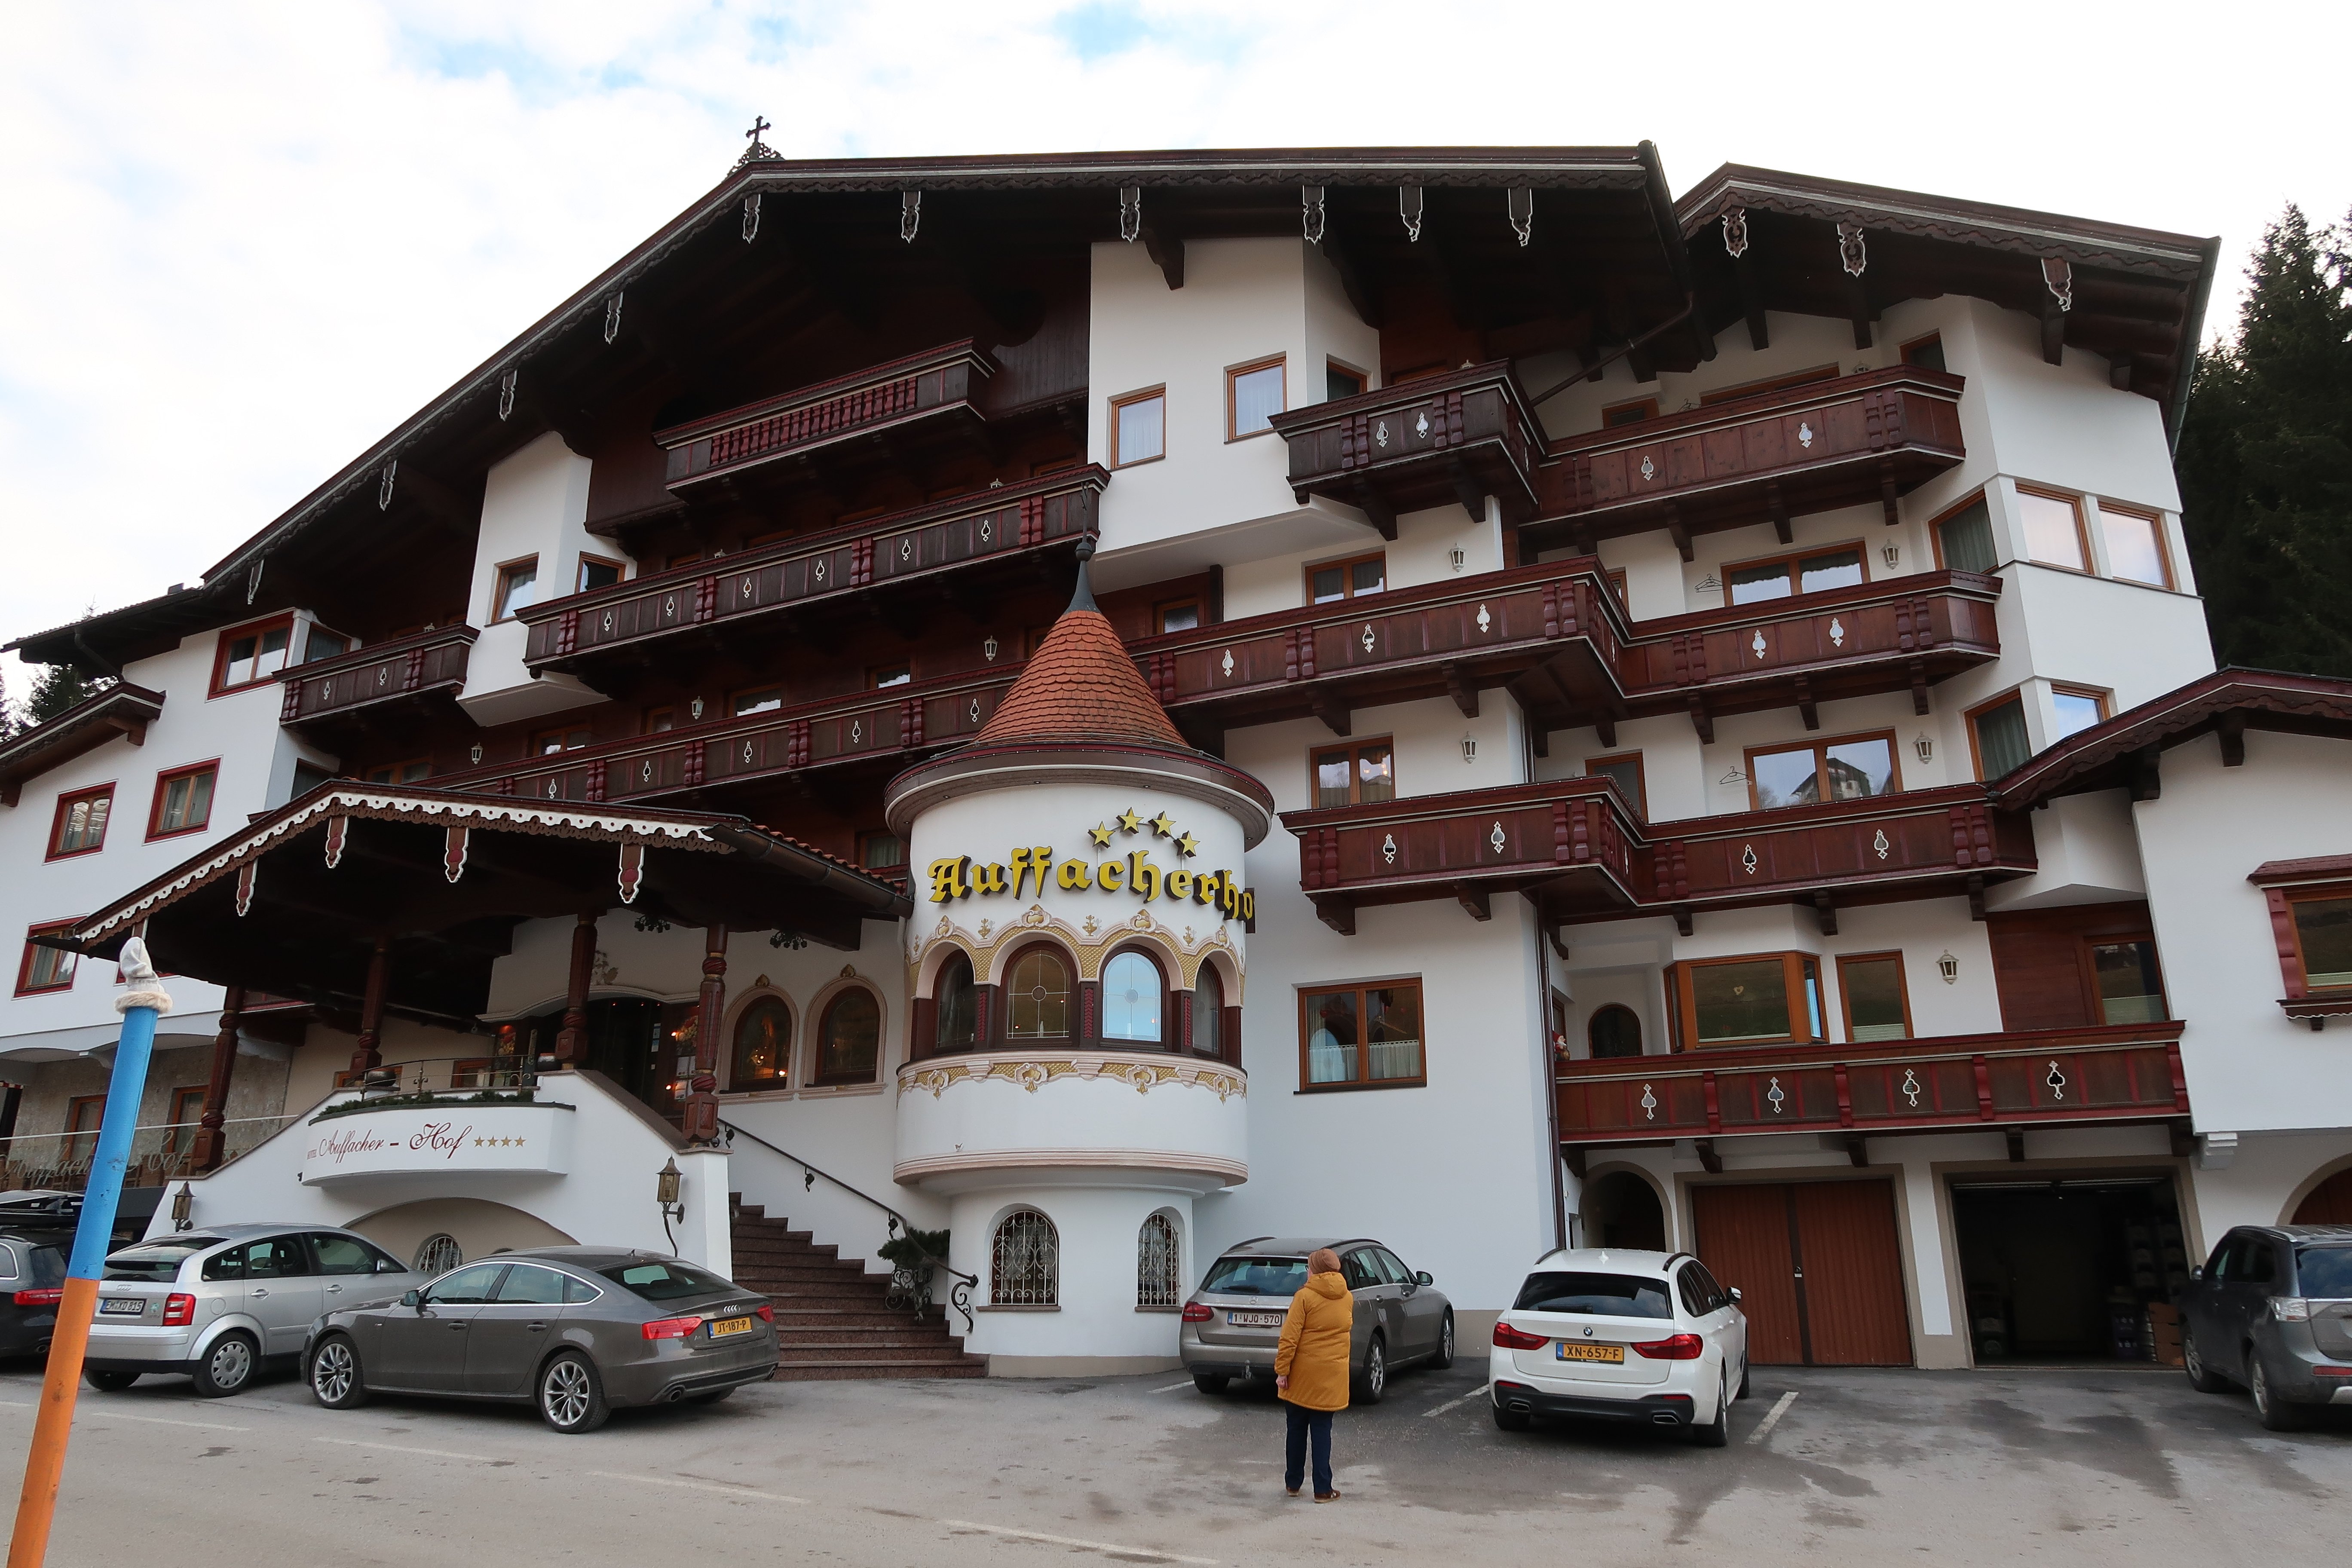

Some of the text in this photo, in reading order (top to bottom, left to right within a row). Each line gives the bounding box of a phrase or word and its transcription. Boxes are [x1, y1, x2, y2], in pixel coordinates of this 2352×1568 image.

[927, 845, 1253, 920] Auffacherho
[319, 1129, 385, 1164] Auffacher
[410, 1122, 472, 1159] Hof
[717, 1320, 747, 1333] JT-187-P
[1567, 1345, 1619, 1359] XN-657-F
